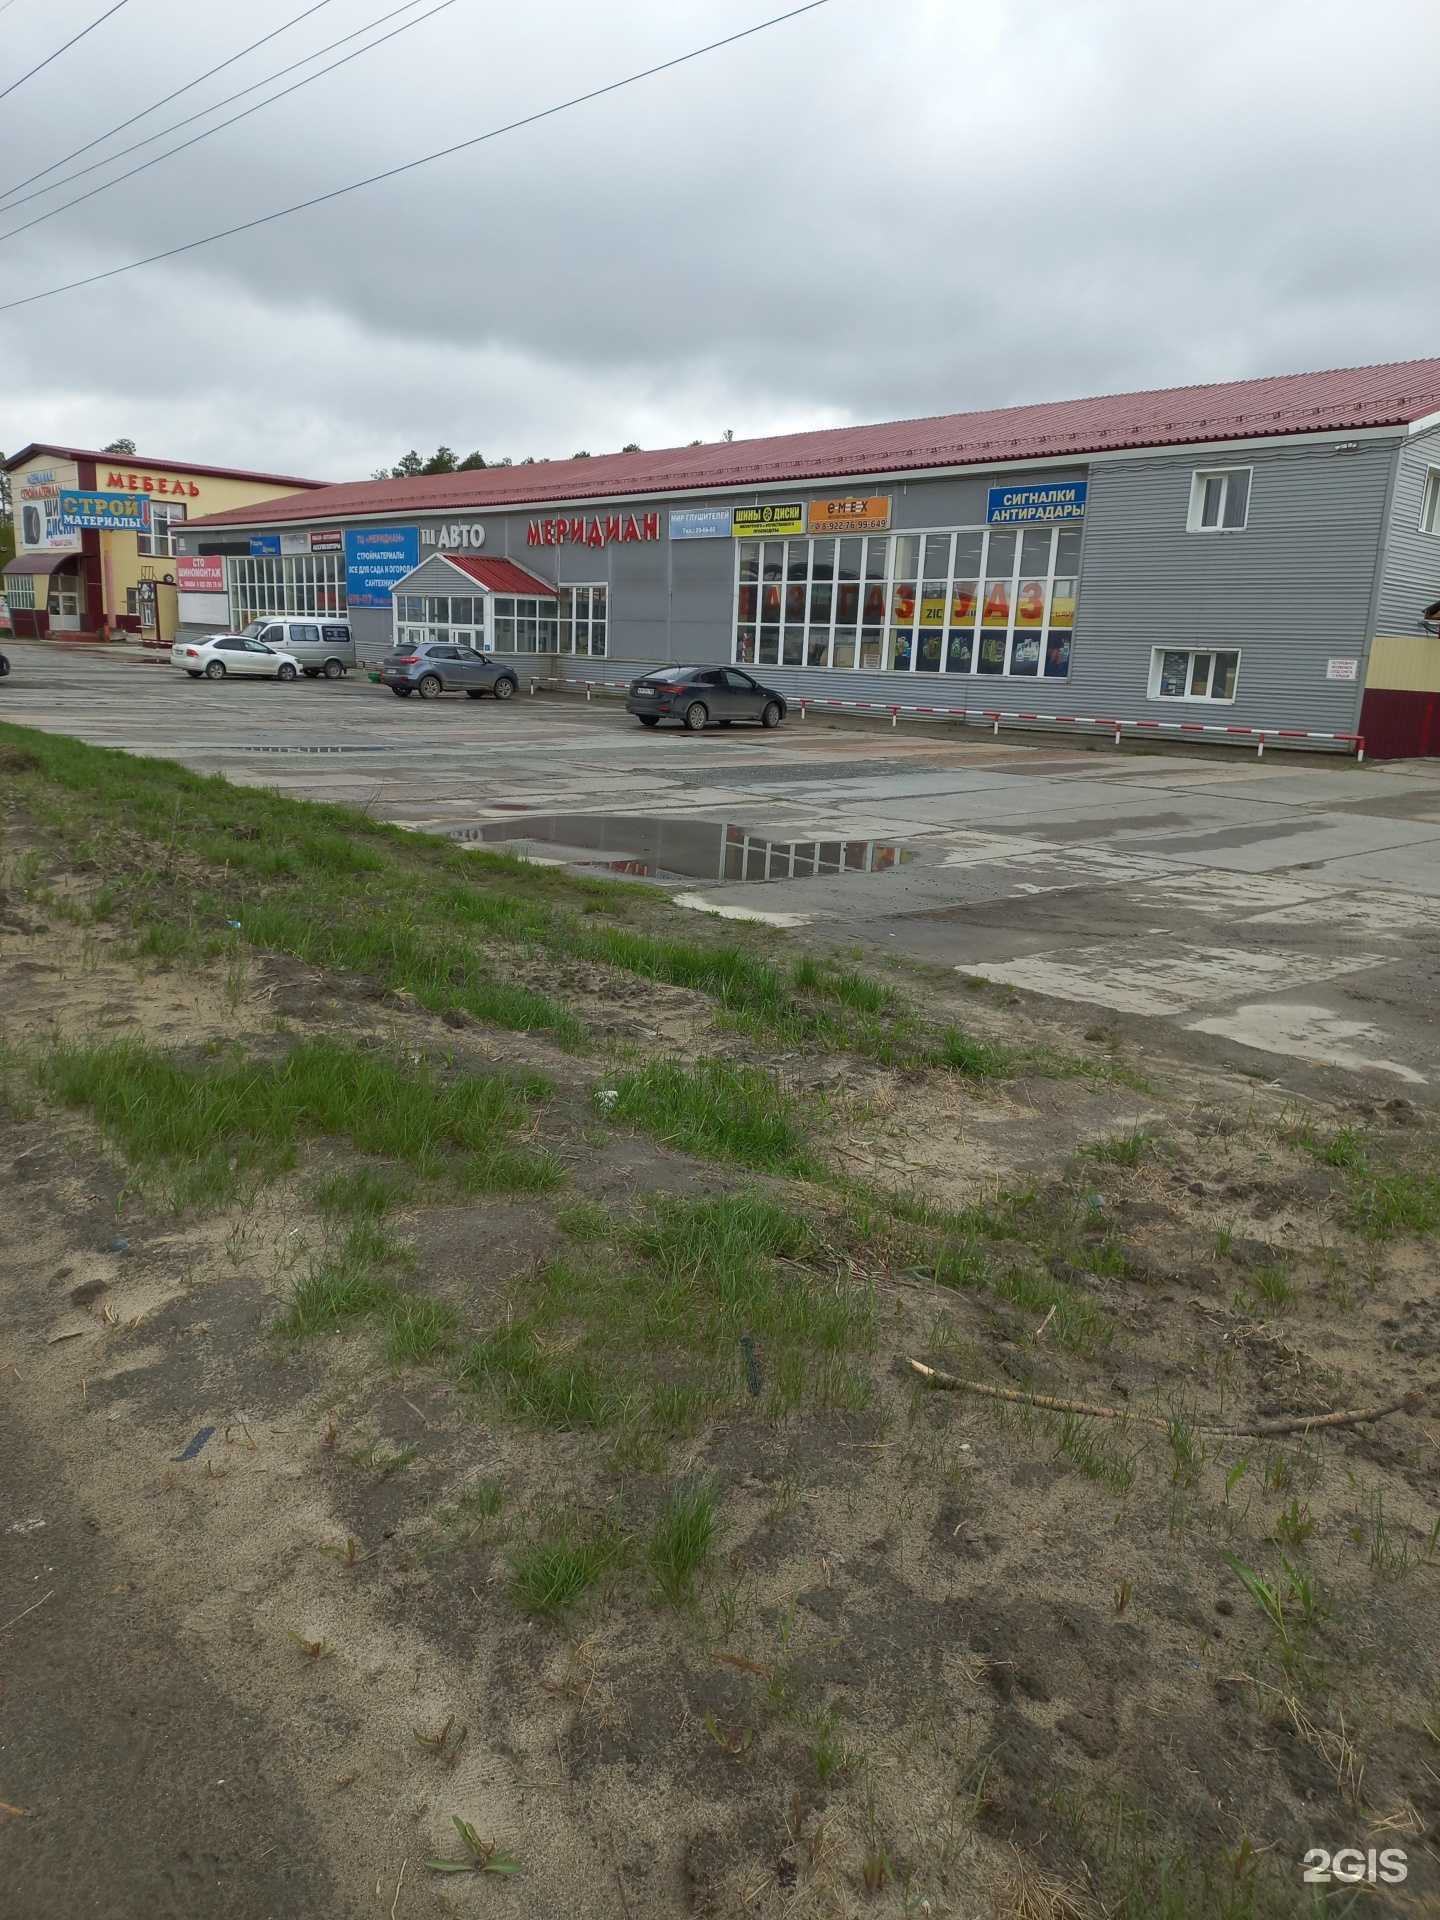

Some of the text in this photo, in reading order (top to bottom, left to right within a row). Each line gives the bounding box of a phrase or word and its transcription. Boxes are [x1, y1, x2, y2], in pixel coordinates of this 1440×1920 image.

[106, 472, 200, 497] МЕБЕЛЬ
[63, 495, 140, 516] СТРОЙ
[1003, 489, 1076, 506] СИГНАЛКИ
[63, 514, 141, 528] МАТЕРИАЛЫ
[685, 510, 730, 521] ГЛУШИТЕЛЕЙ
[735, 506, 801, 522] ШИНЫ ДИСКИ
[991, 504, 1085, 521] АНТИРАДАРЫ
[437, 523, 486, 549] АВТО
[526, 512, 661, 548] МЕРИДИАН
[192, 557, 205, 568] СТО
[356, 551, 405, 560] СТРОЙМАТЕРИАЛЫ
[952, 582, 1044, 620] УАЗ
[926, 608, 943, 619] ZIC
